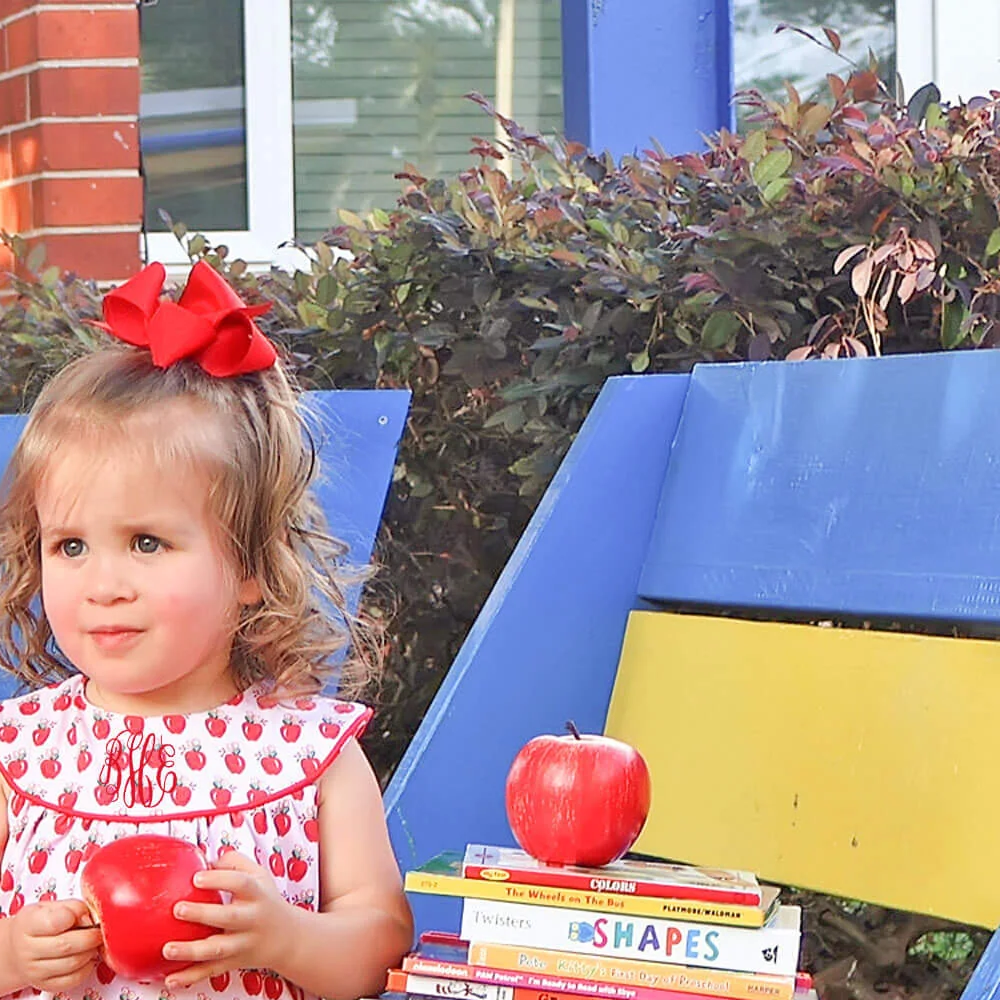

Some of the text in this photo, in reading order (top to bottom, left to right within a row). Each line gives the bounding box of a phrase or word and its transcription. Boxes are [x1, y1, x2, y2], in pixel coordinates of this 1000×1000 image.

[590, 879, 637, 893] COLORS
[505, 887, 625, 909] The Wheels on The Bus
[474, 910, 533, 930] Twisters
[592, 918, 720, 962] SHAPES
